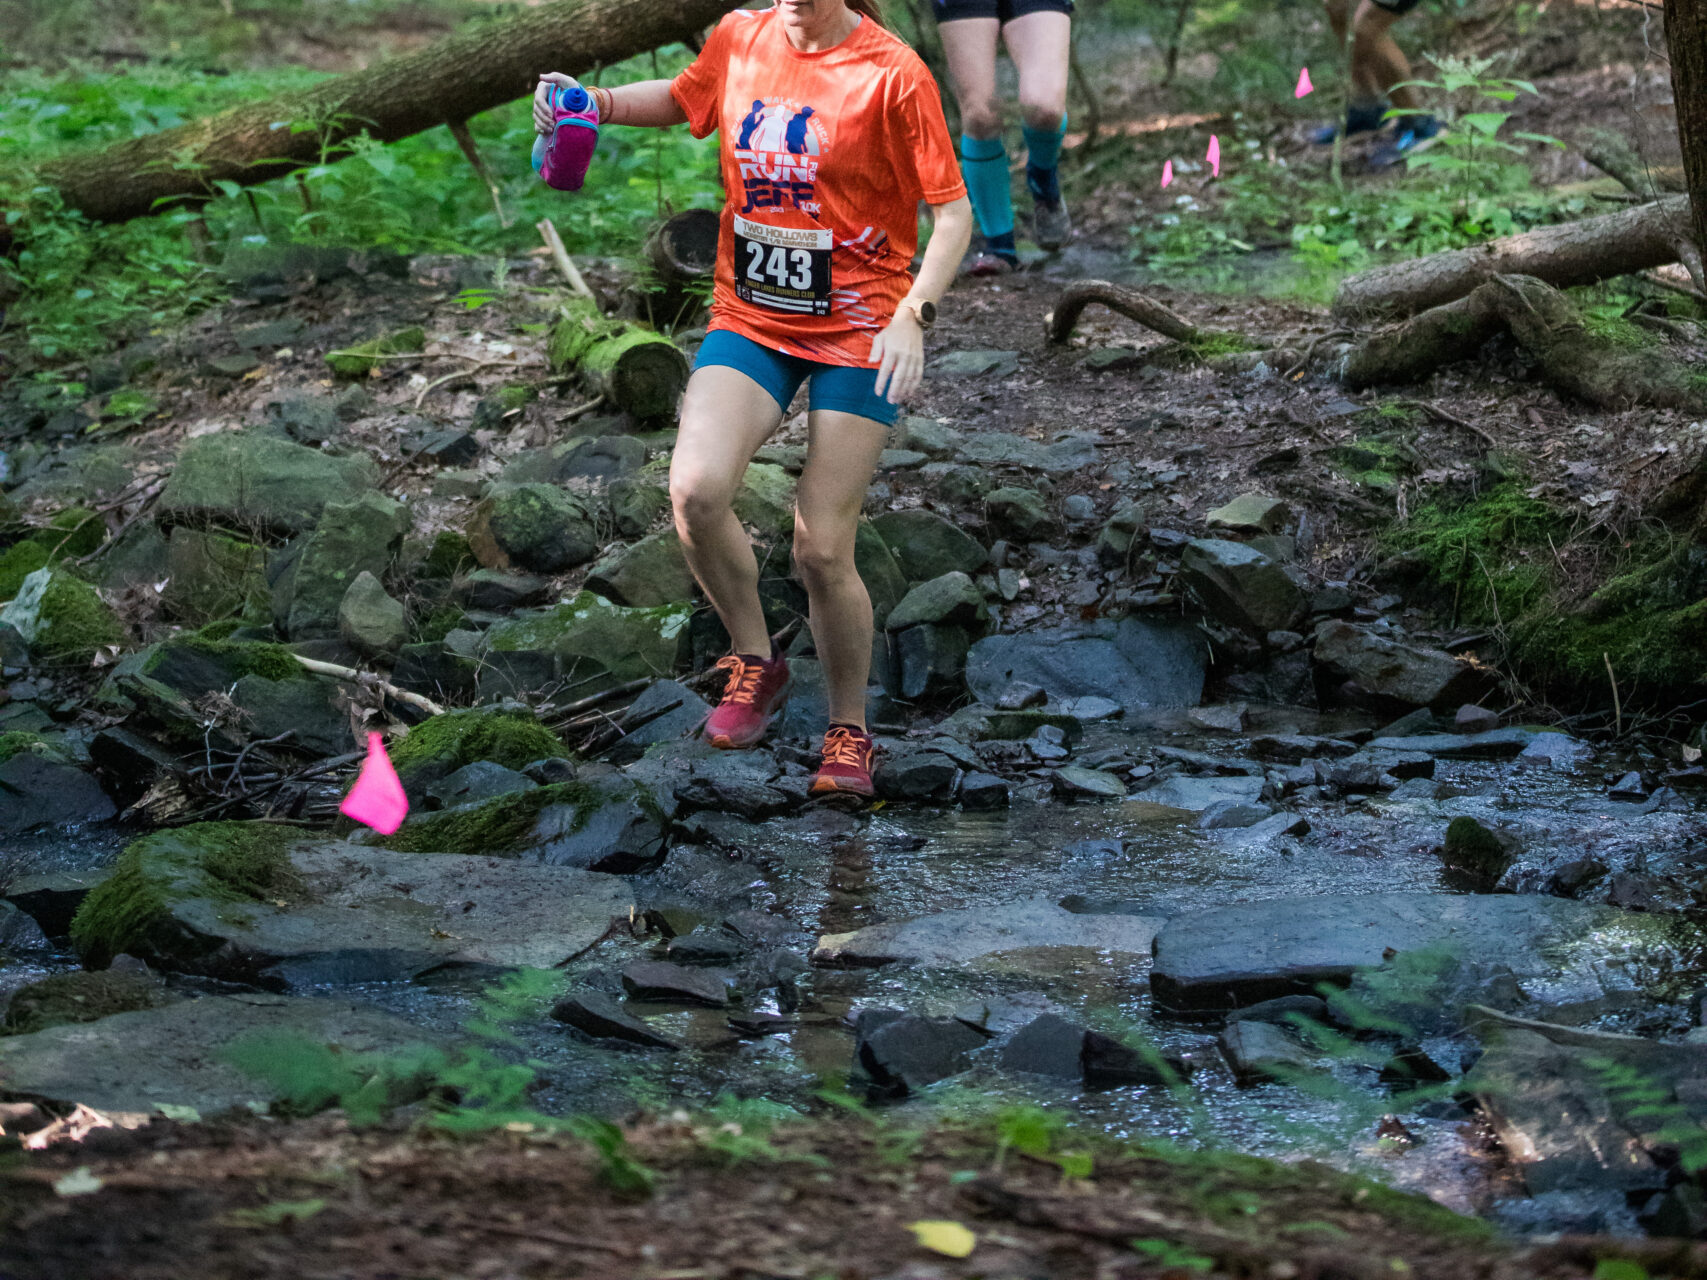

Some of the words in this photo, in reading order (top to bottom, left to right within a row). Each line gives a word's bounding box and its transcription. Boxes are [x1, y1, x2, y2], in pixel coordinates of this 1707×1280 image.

[763, 96, 792, 106] WALK
[812, 116, 830, 145] RUCK
[733, 150, 809, 182] RUN
[808, 161, 819, 181] FOR
[741, 178, 814, 214] JEFF
[800, 200, 821, 214] 10K
[743, 221, 763, 234] TWO
[766, 228, 818, 241] HOLLOWS
[746, 240, 812, 290] 243
[801, 290, 816, 298] CLUB
